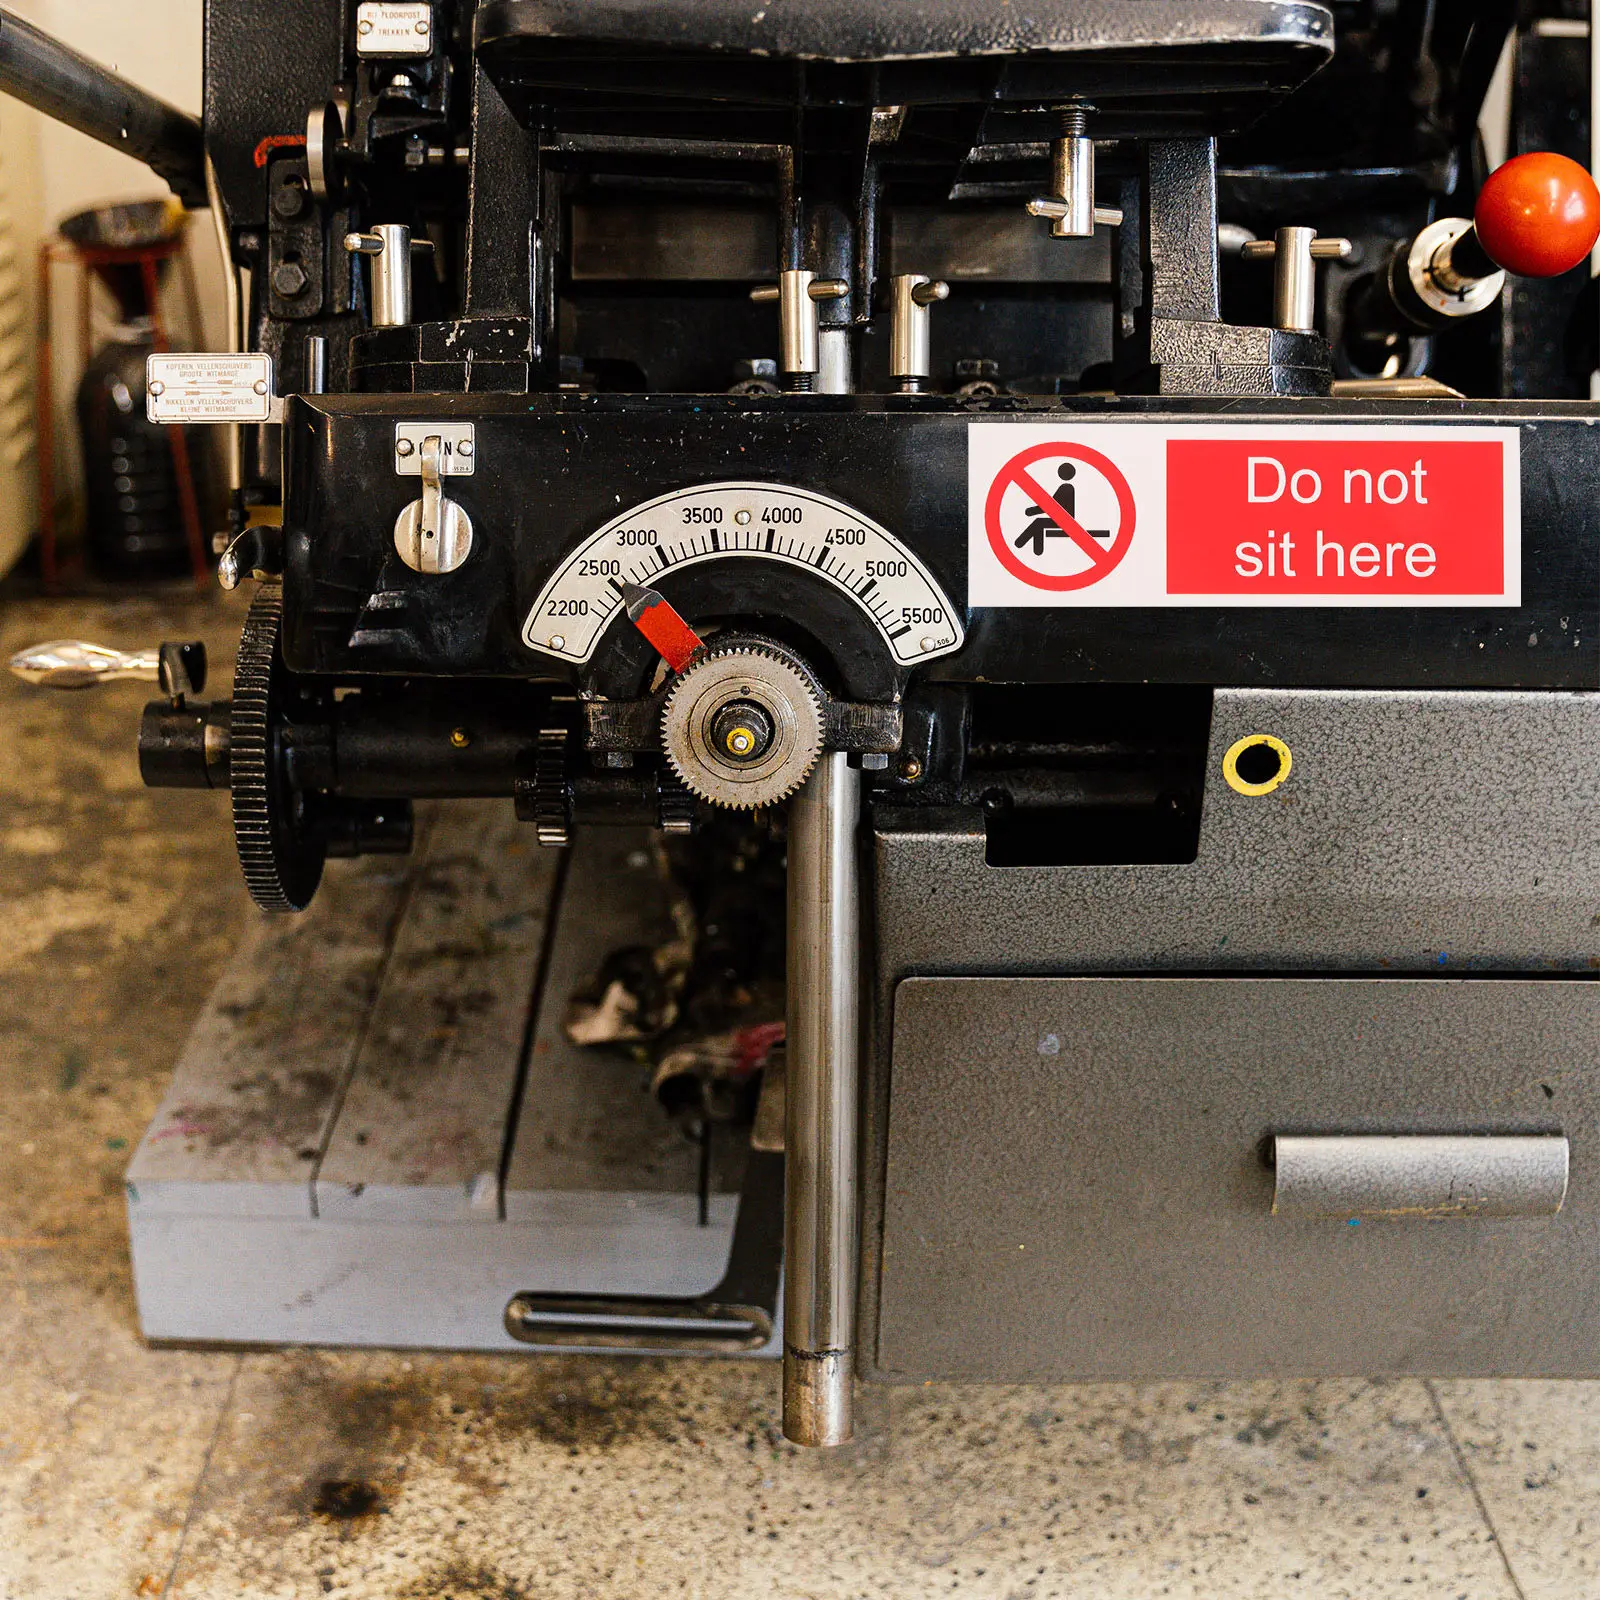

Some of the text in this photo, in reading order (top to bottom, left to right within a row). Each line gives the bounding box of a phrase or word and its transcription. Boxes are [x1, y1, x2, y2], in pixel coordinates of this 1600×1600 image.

[1247, 456, 1428, 504] Do not
[682, 507, 723, 524] 3500
[761, 507, 803, 524] 4000
[616, 529, 658, 546] 3000
[824, 529, 866, 546] 4500
[1234, 530, 1437, 578] sit here
[578, 560, 620, 576] 2500
[865, 561, 907, 577] 5000
[547, 600, 588, 616] 2200
[902, 607, 943, 624] 5500
